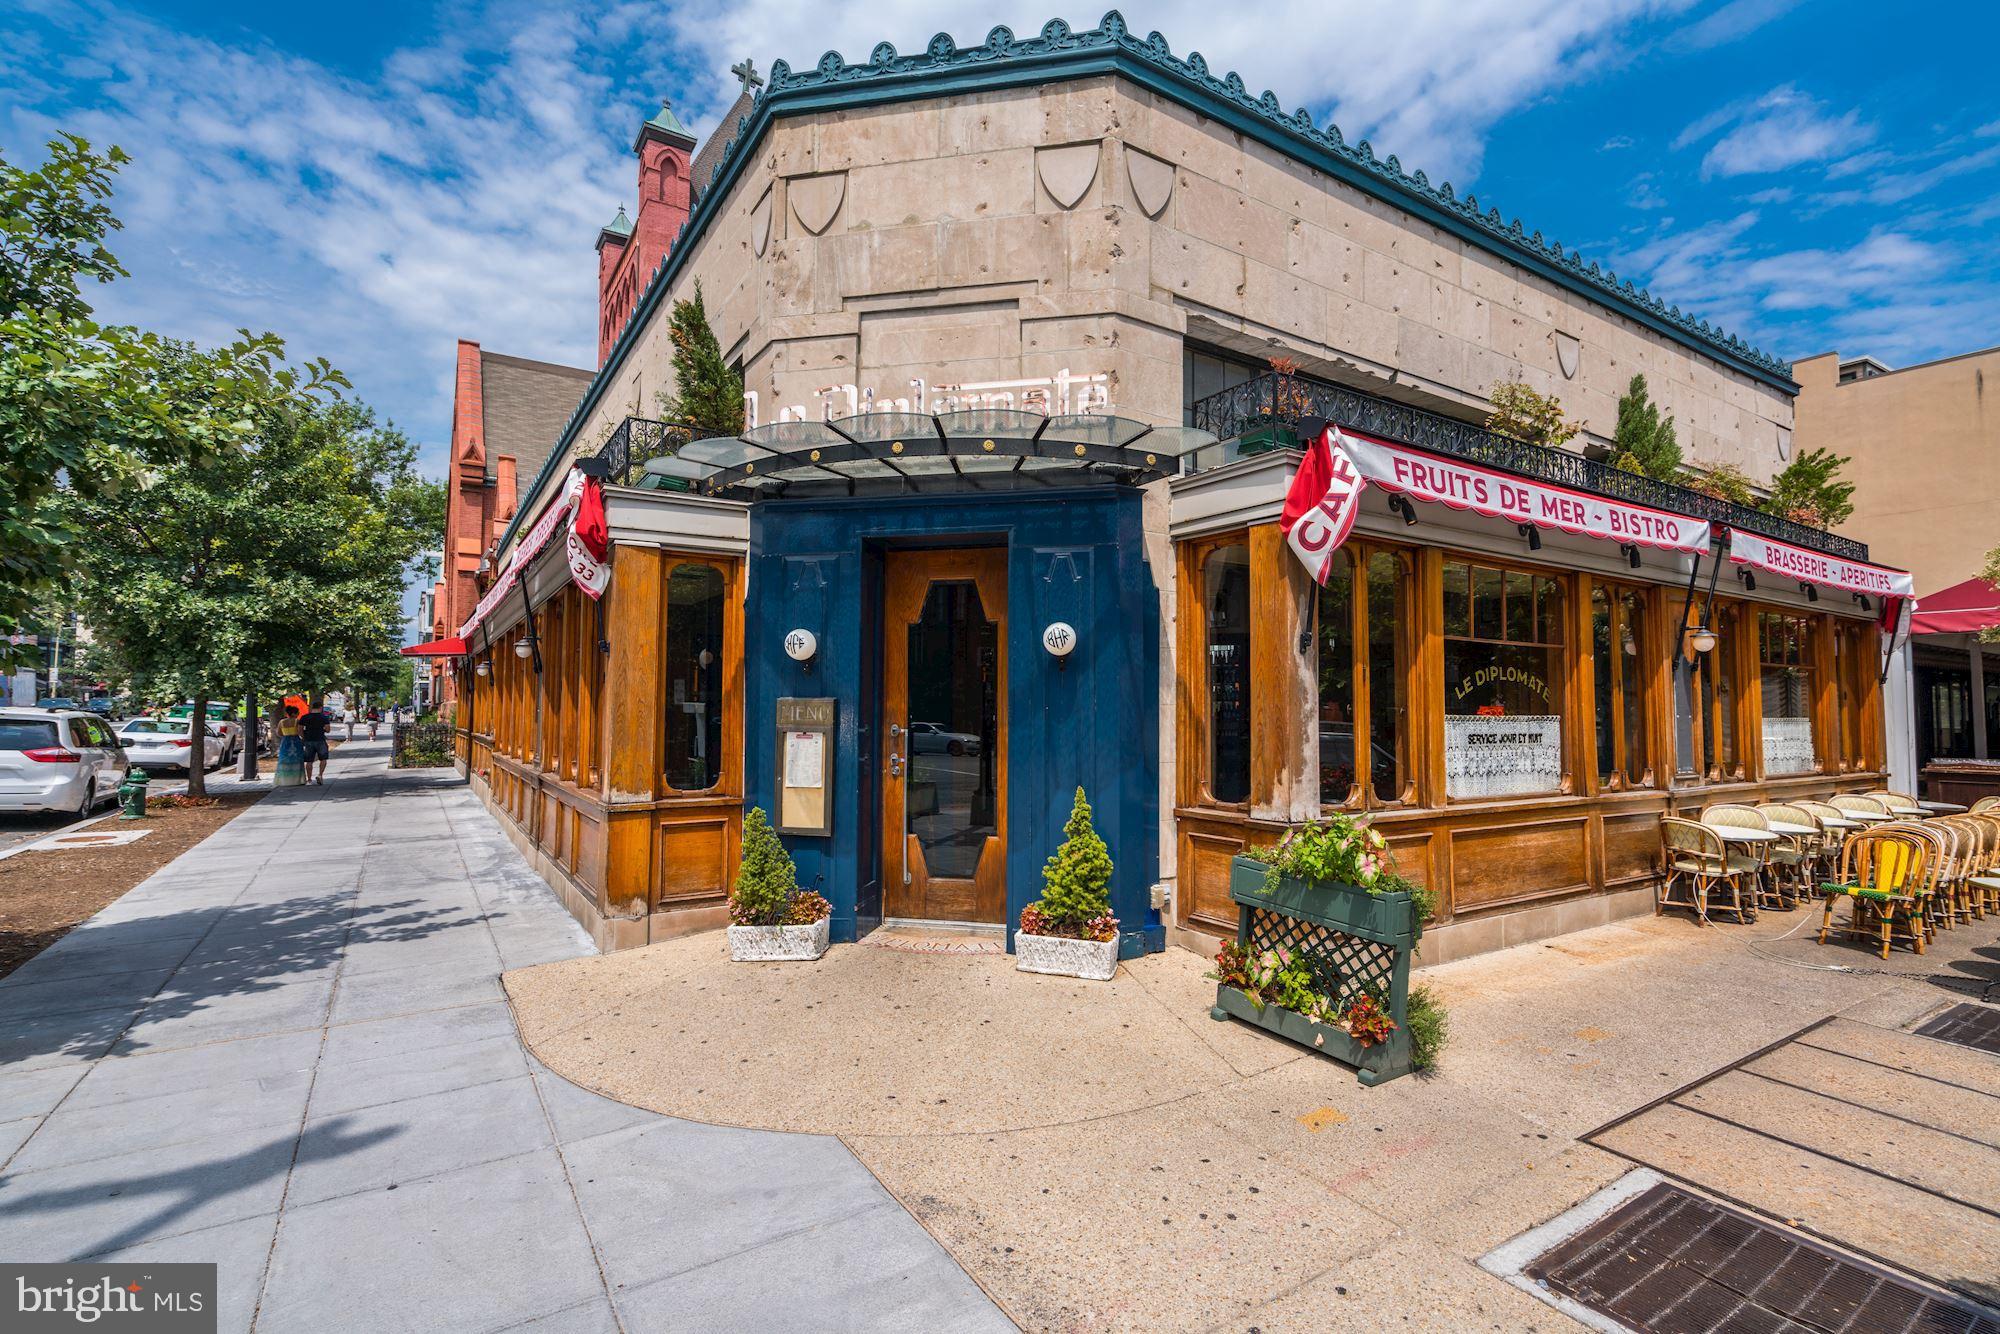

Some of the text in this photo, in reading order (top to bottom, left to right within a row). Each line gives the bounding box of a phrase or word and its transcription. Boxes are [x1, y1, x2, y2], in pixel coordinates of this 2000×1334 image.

[1393, 455, 1489, 504] FRUITS
[1499, 483, 1532, 514] DE
[1540, 493, 1588, 526] MER
[1608, 508, 1680, 543] BISTRO
[1765, 545, 1829, 580] BRASSERIE
[1454, 665, 1552, 703] LE DIPLOMATE
[780, 705, 830, 721] MENU
[1467, 733, 1543, 745] SERVICE JOUR ET NUIT
